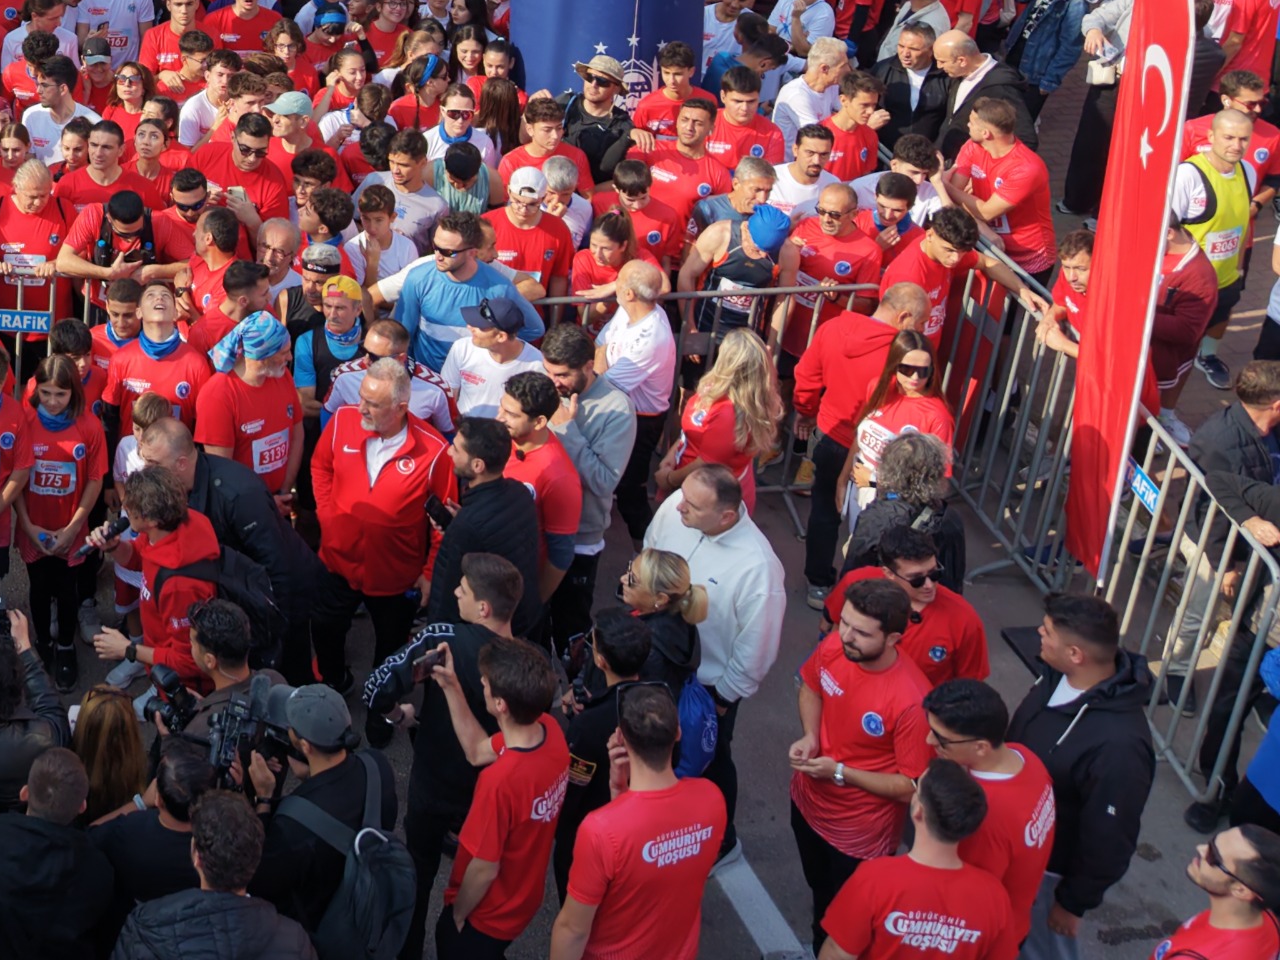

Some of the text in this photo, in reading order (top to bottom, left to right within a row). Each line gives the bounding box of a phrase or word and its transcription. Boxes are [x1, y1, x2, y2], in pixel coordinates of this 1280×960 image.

[40, 474, 62, 487] 175
[642, 826, 713, 863] CUMHURİYET
[657, 843, 701, 868] KOŞUSU
[884, 911, 982, 943] CUMHURİYET
[903, 932, 959, 954] KOŞUSU
